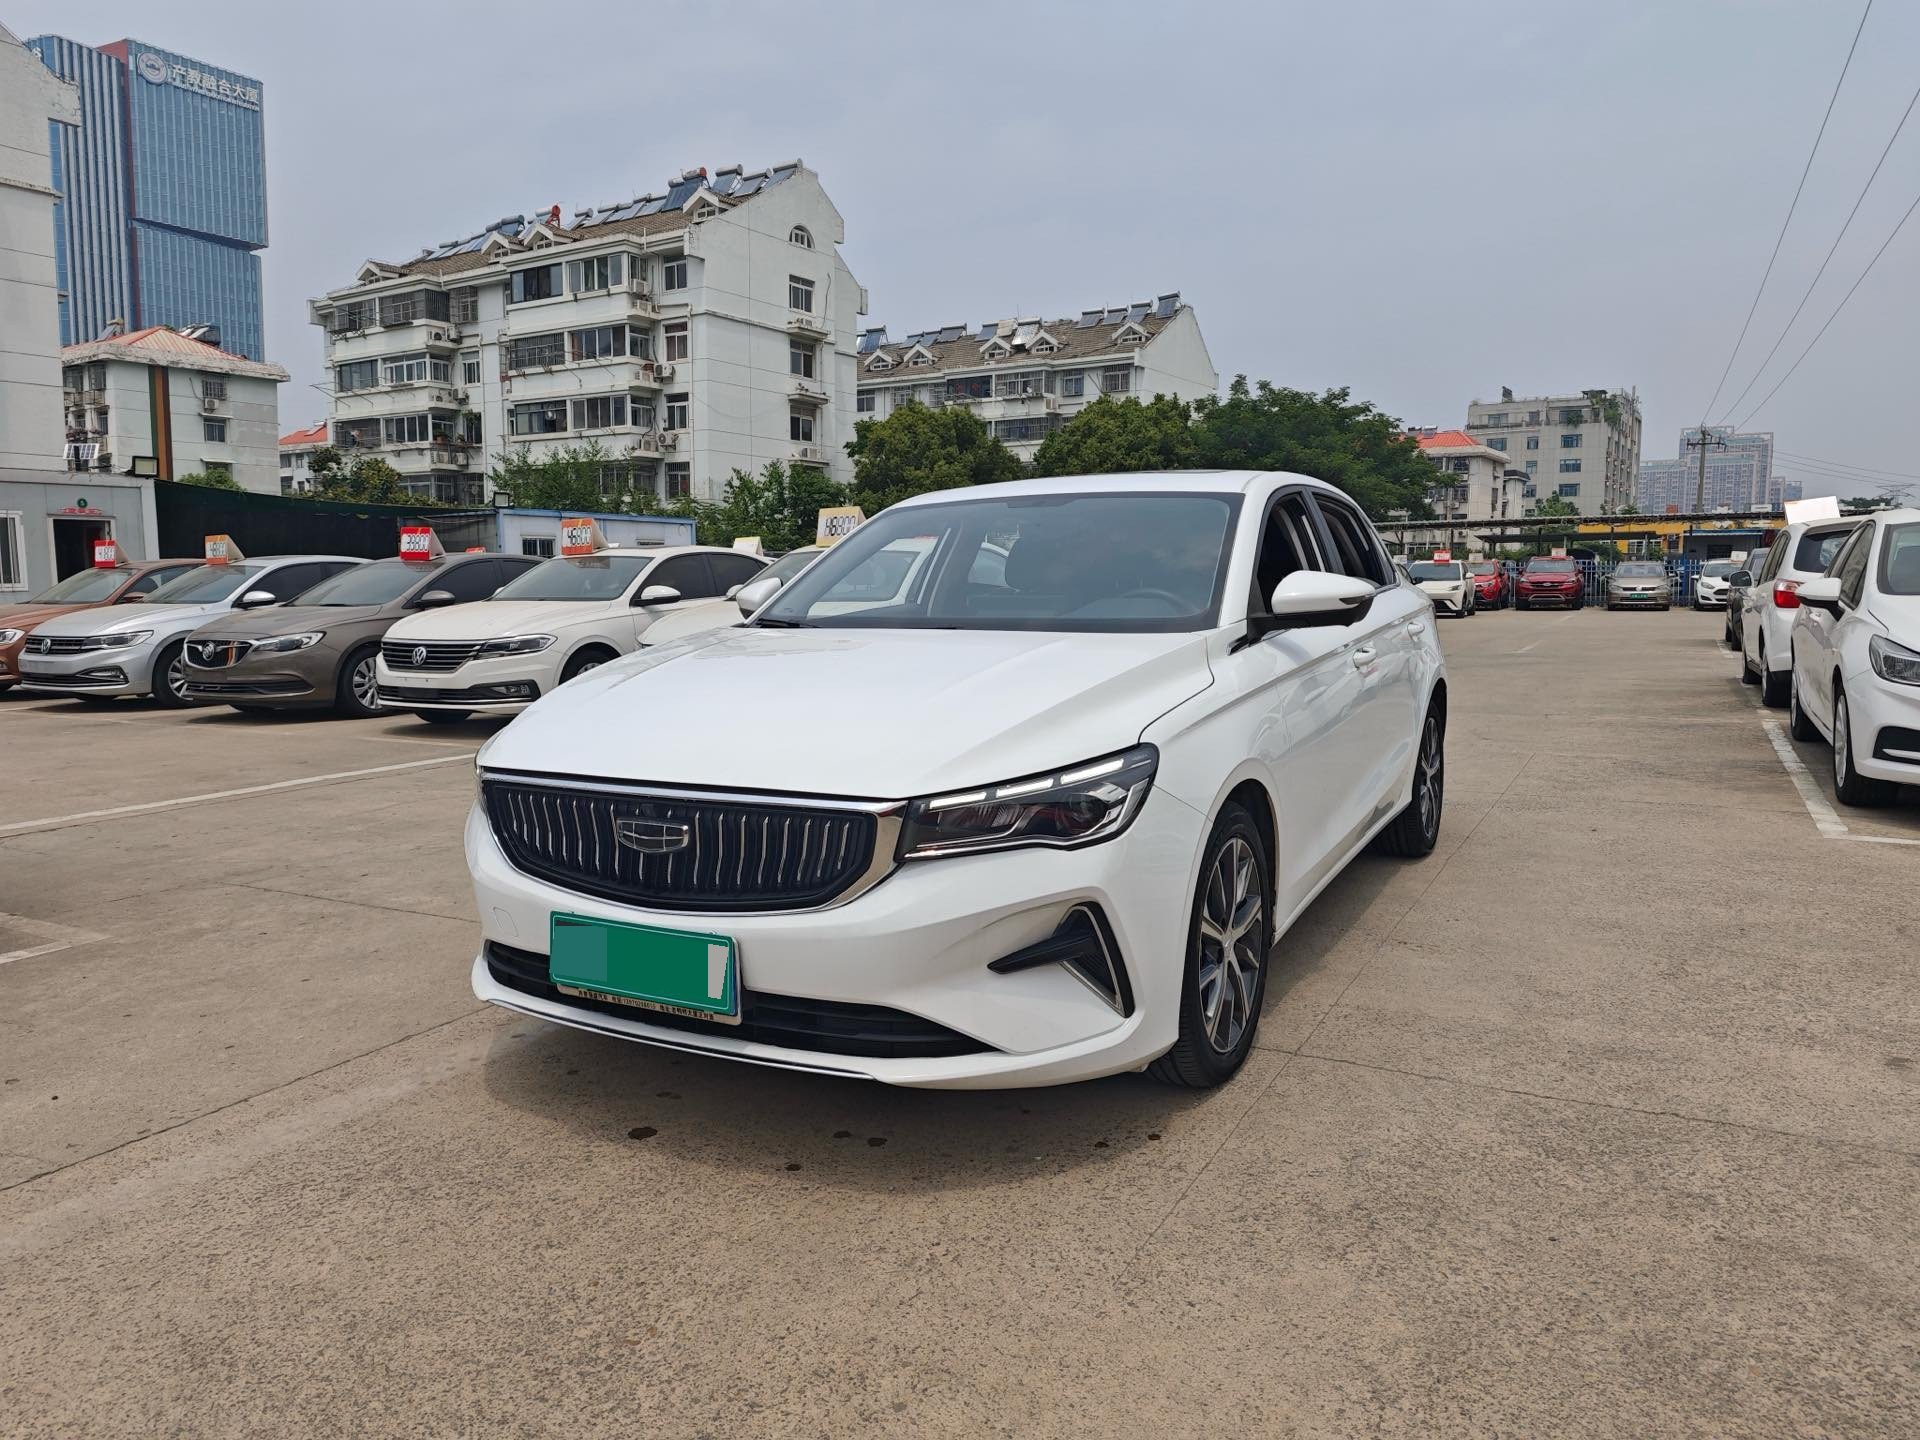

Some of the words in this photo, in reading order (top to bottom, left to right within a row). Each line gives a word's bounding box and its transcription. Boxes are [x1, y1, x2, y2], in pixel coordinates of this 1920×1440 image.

[172, 65, 259, 104] 产教融合大厦
